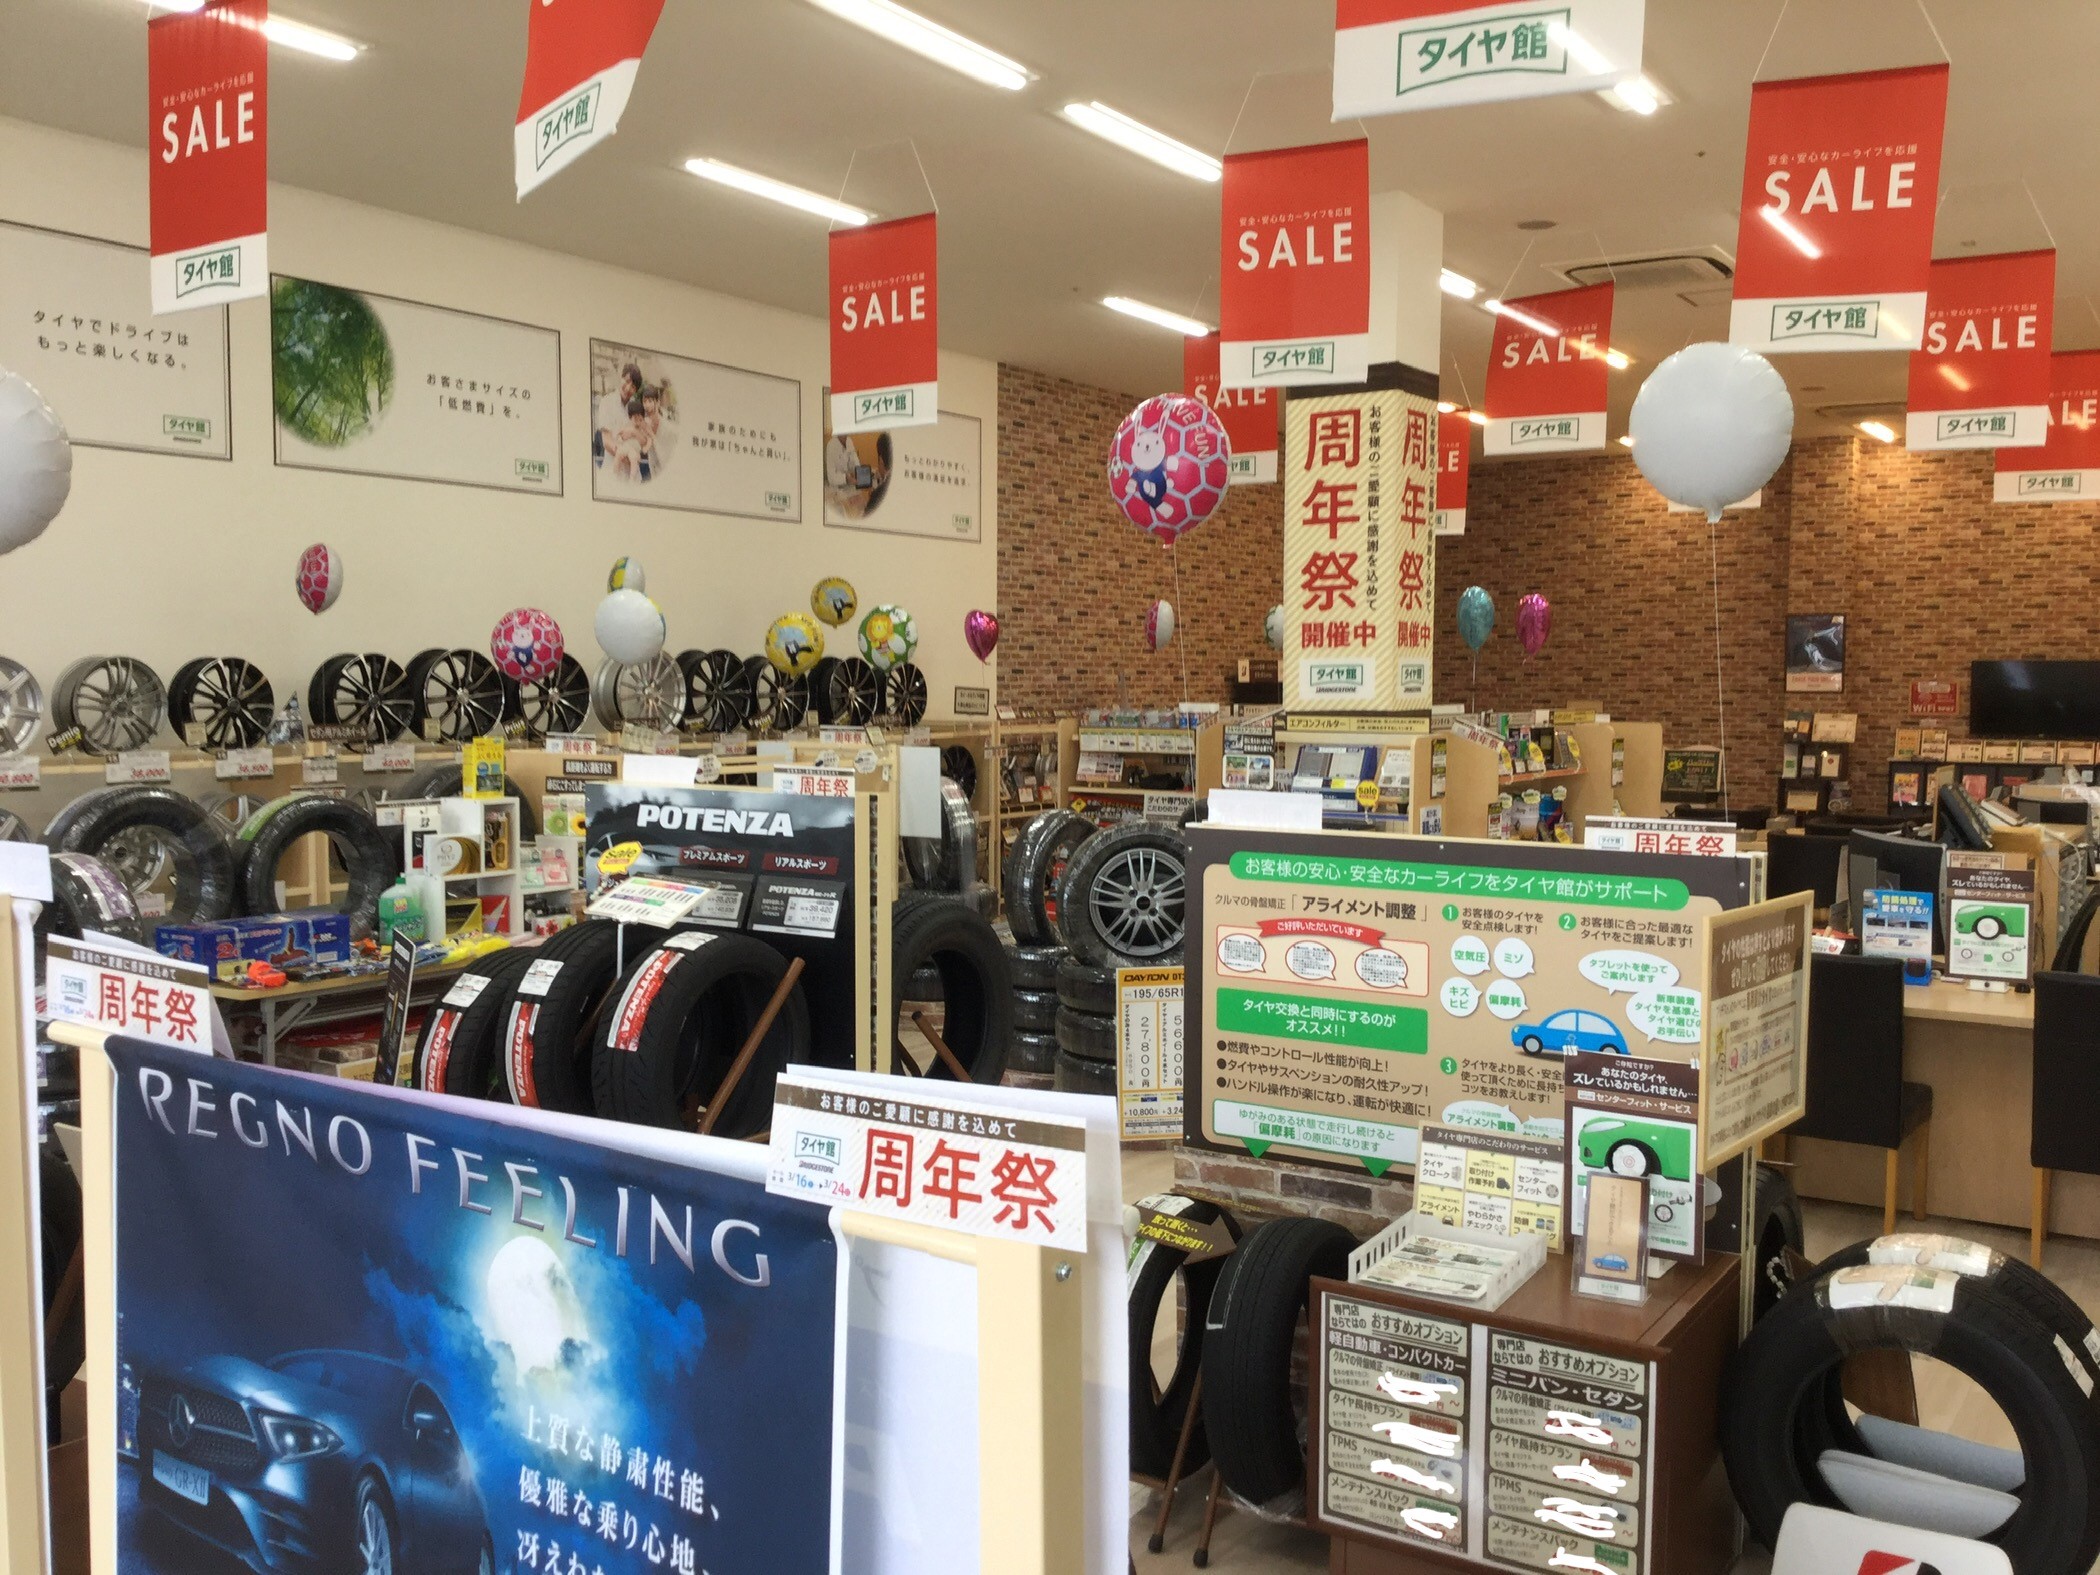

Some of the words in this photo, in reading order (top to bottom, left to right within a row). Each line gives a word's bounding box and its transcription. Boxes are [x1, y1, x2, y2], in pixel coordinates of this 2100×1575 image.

[1418, 25, 1548, 73] タイヤ館
[162, 92, 254, 163] SALE
[543, 95, 590, 150] タイヤ館
[1764, 162, 1916, 217] SALE
[1238, 222, 1352, 271] SALE
[183, 252, 234, 285] タイヤ館
[842, 285, 925, 331] SALE
[34, 310, 189, 347] タイヤでドライブは
[1785, 307, 1866, 331] タイヤ館
[1926, 315, 2037, 355] SALE
[38, 336, 187, 370] もっと楽しくなる。
[1263, 346, 1325, 367] タイヤ館
[1502, 333, 1597, 368] SALE
[427, 373, 531, 400] お客さまサイズの
[861, 394, 907, 415] タイヤ館
[1520, 422, 1571, 437] タイヤ館
[1947, 416, 2007, 433] タイヤ館
[2027, 475, 2074, 490] タイヤ館
[1301, 408, 1361, 611] 周年祭
[1399, 408, 1428, 612] 周年祭
[1301, 620, 1376, 649] 開催中
[1397, 621, 1431, 649] 開催中
[1316, 668, 1357, 681] タイヤ館
[800, 776, 848, 797] 周年祭
[1358, 786, 1377, 796] sale
[637, 804, 794, 838] POTENZA
[1635, 832, 1724, 857] 周年祭
[683, 850, 745, 864] プレミアムスポーツ
[775, 857, 827, 871] リアルスポーツ
[768, 885, 815, 897] POTENZA
[1245, 858, 1668, 903] お客様の安心・安全なカーライフをタイヤ館がサポート
[1215, 893, 1286, 911] クルマの骨盤矯正
[1291, 893, 1428, 922] 「アライメント調整」
[1462, 907, 1544, 923] お客様のタイヤを
[1277, 920, 1364, 938] ご好評いただいています
[1461, 920, 1538, 935] 安全点検します!
[1580, 916, 1693, 935] お客様に合った最適な
[1580, 929, 1693, 948] タイヤをご提案します!
[1454, 950, 1486, 962] 空気圧
[1590, 958, 1668, 974] タブレットを使って
[1124, 973, 1169, 982] DAYTON
[1601, 971, 1656, 983] ご案内します
[620, 961, 662, 1038] POTENZA
[1449, 985, 1469, 998] キズ
[1489, 994, 1522, 1008] 偏摩耗
[1657, 994, 1695, 1006] 新車装着
[98, 971, 198, 1045] 周年祭
[1243, 998, 1396, 1028] タイヤ交換と同時にするのが
[1285, 1019, 1346, 1037] オススメ!!
[1657, 1027, 1695, 1038] お手伝い
[514, 1018, 527, 1098] POTENZA
[1462, 1058, 1564, 1081] タイヤをより長く・安全
[1601, 1067, 1668, 1084] あなたのタイヤ、
[1461, 1083, 1551, 1104] コツをお教えします!
[1596, 1093, 1691, 1114] センターフィット・サービス
[820, 1093, 1017, 1140] お客様のご愛顧に感謝を込めて
[1239, 1109, 1395, 1142] ゆがみのある状態で走行し続けると
[1447, 1113, 1516, 1132] アライメント調整
[1252, 1120, 1380, 1152] 「偏摩耗」の原因になります
[1437, 1131, 1549, 1155] タイヤ専門店のこだわりのサービス
[801, 1136, 836, 1158] タイヤ館
[1422, 1168, 1450, 1179] クローク
[1423, 1159, 1443, 1168] タイヤ
[1469, 1167, 1494, 1177] 取り付け
[138, 1067, 373, 1176] REGNO
[406, 1131, 770, 1288] FEELING
[859, 1128, 1058, 1234] 周年祭
[1518, 1175, 1547, 1185] センター
[1517, 1184, 1542, 1194] フィット
[1420, 1200, 1460, 1213] アライメント
[1467, 1210, 1503, 1222] やわらかさ
[1466, 1220, 1492, 1230] チェック
[1334, 1304, 1359, 1317] 専門店
[1331, 1316, 1367, 1329] ならではの
[1371, 1312, 1463, 1346] おすすめオプション
[1329, 1330, 1467, 1371] 軽自動車・コンパクトカー
[1497, 1339, 1525, 1351] 専門店
[1494, 1351, 1533, 1365] ならではの
[1538, 1348, 1640, 1383] おすすめオプション
[1491, 1367, 1643, 1411] ミニバン・セダン
[1332, 1393, 1403, 1419] タイヤ長持ちプラン
[1332, 1434, 1358, 1451] TPMS
[1494, 1433, 1573, 1460] タイヤ長持ちプラン
[520, 1404, 719, 1521] 上質な静粛性能、
[1332, 1476, 1410, 1505] メンテナンスパック
[1493, 1476, 1522, 1494] TPMS
[1491, 1520, 1579, 1550] メンテナンスパック
